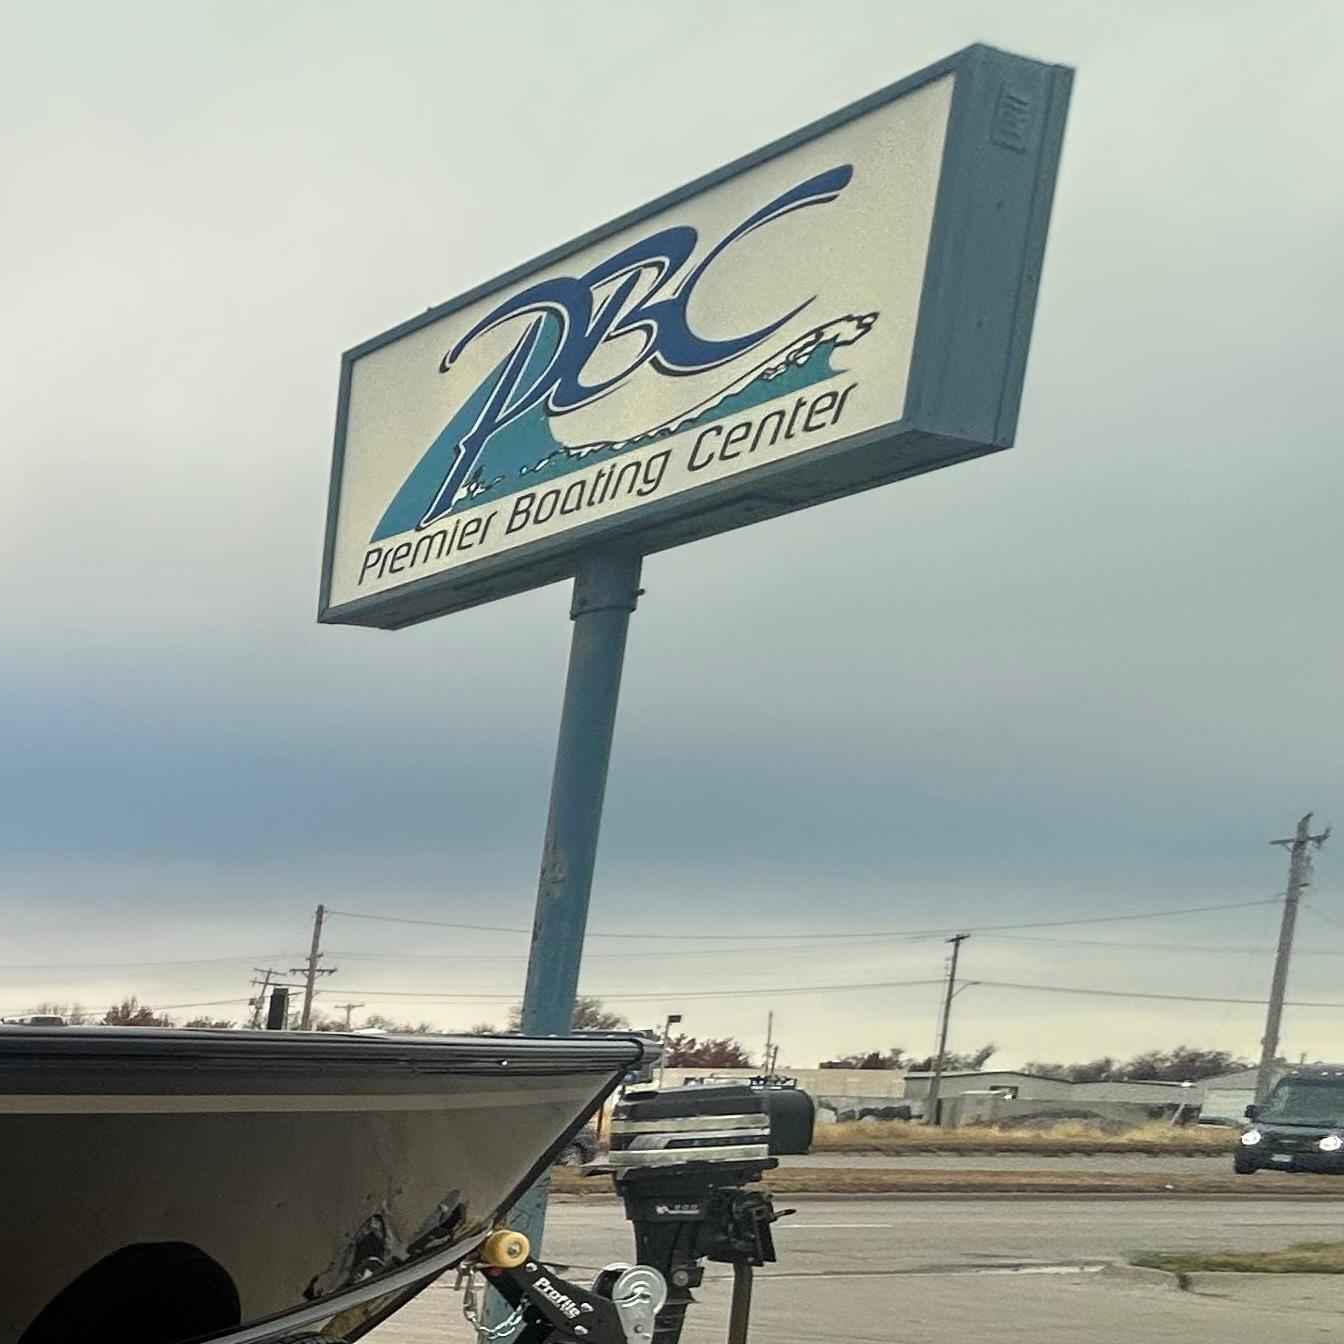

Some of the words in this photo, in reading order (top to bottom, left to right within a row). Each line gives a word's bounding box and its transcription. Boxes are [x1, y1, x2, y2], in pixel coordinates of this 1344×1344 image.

[357, 510, 498, 586] Premier
[504, 448, 673, 536] Boating
[687, 382, 858, 472] Center
[415, 163, 854, 531] PBC
